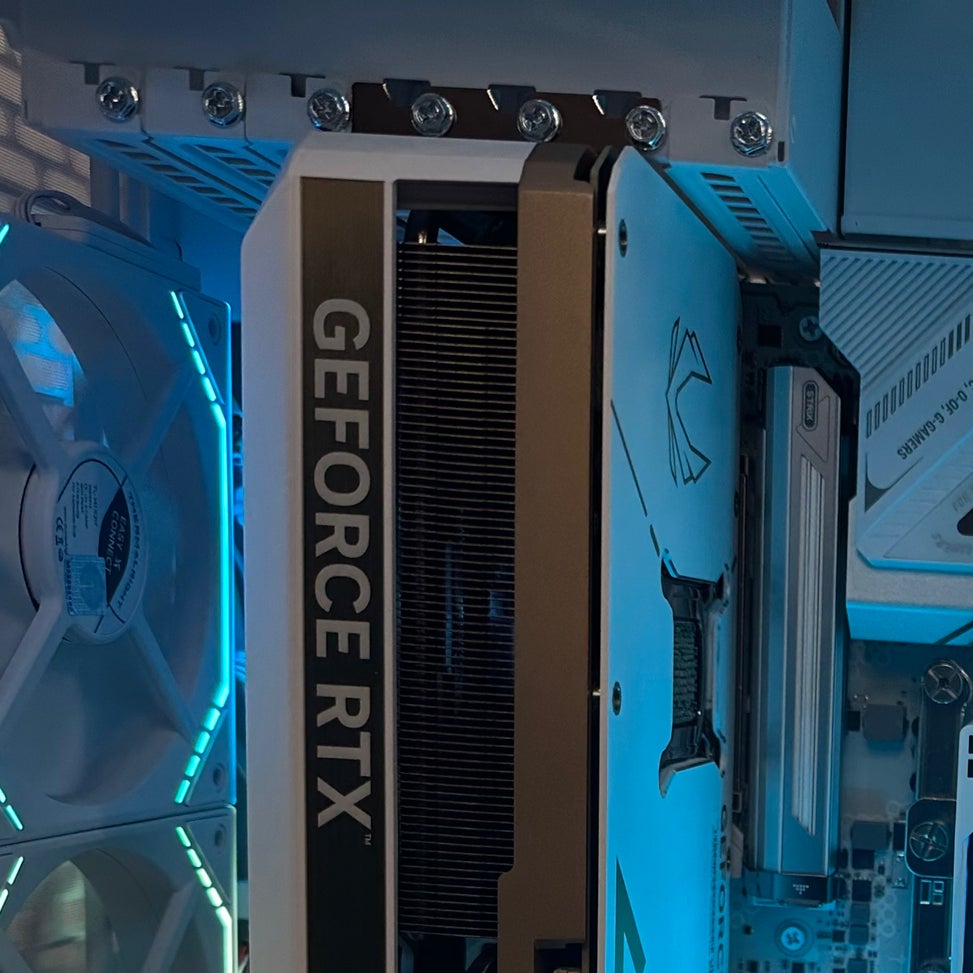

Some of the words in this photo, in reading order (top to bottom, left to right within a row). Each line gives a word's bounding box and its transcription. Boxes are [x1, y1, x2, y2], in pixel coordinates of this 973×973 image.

[941, 390, 968, 415] O-OF,
[897, 412, 945, 461] G-GAMERS
[312, 297, 373, 660] GEFORCE
[105, 509, 120, 577] CONNECT
[115, 515, 127, 553] EASY
[315, 684, 373, 829] RTX
